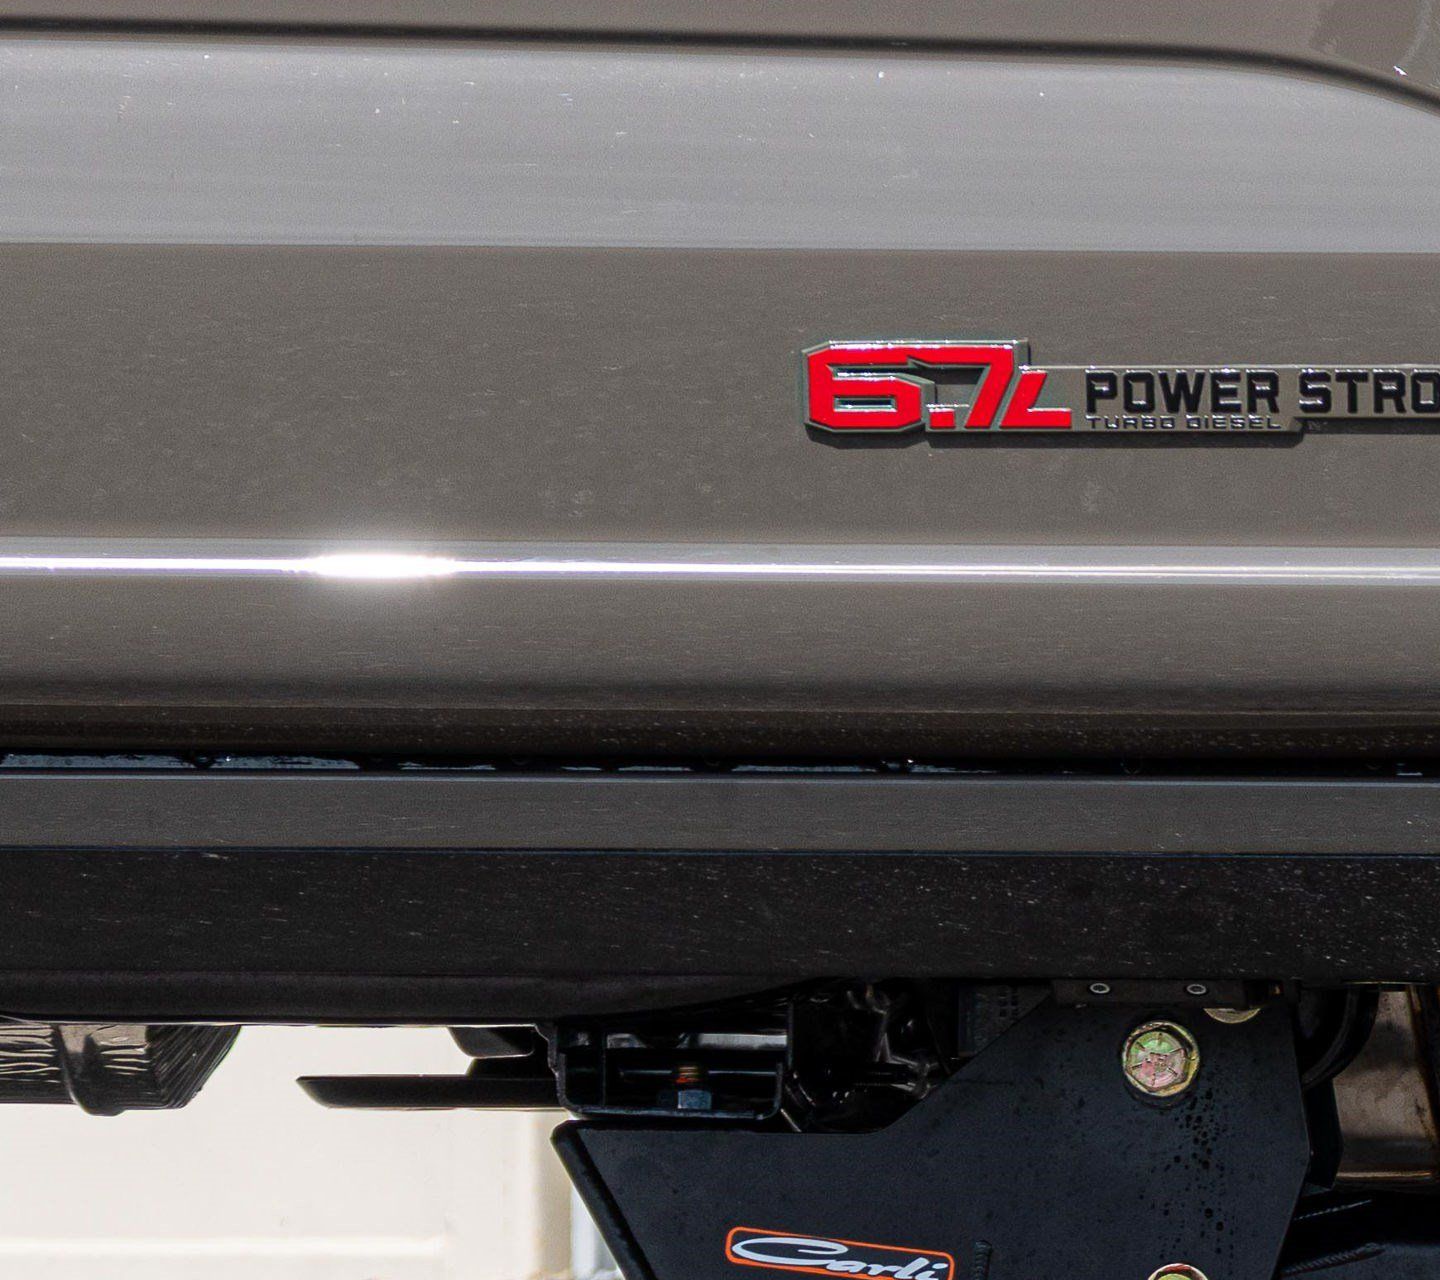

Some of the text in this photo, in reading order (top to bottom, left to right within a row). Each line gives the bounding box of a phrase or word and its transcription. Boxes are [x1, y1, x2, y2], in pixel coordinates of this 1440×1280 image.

[804, 340, 1074, 431] 6.7L
[1085, 369, 1281, 416] POWER
[1086, 416, 1284, 431] TURBO DIESEL
